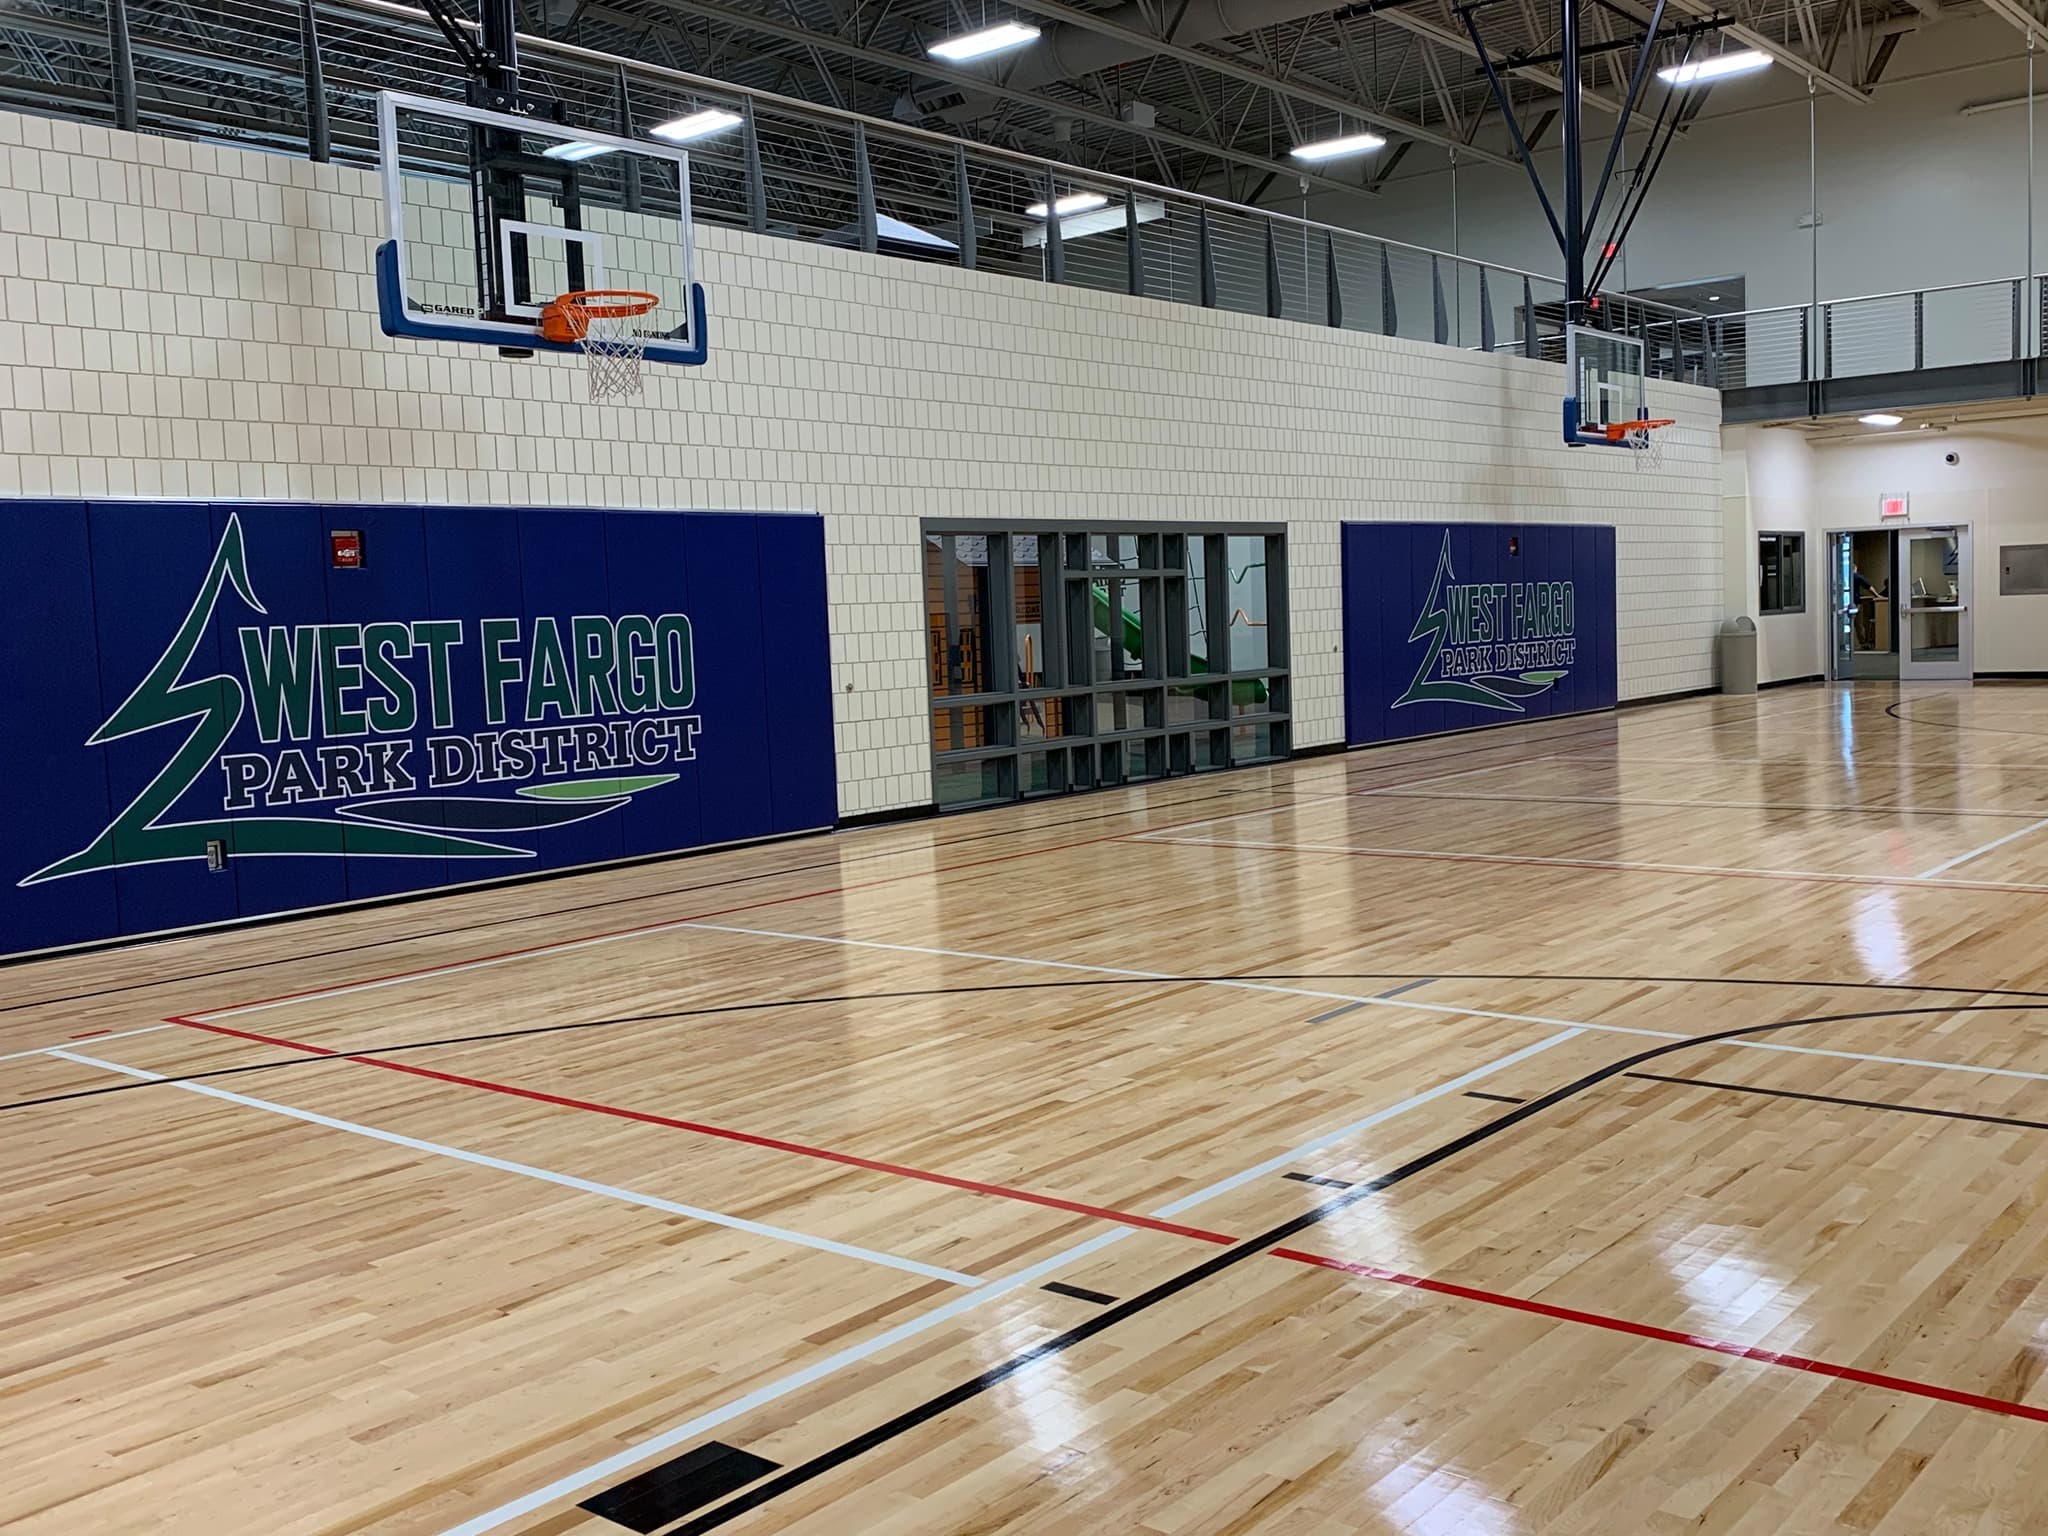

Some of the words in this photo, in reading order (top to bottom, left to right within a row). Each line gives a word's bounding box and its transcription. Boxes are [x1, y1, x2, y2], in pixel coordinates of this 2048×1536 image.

[435, 304, 475, 315] GARED
[1446, 584, 1507, 645] WEST
[1511, 581, 1575, 640] FARGO
[238, 622, 463, 744] WEST
[480, 613, 696, 725] FARGO
[1441, 645, 1493, 678] PARK
[1495, 638, 1576, 672] DISTRICT
[220, 739, 417, 811] PARK
[427, 715, 702, 789] DISTRICT
